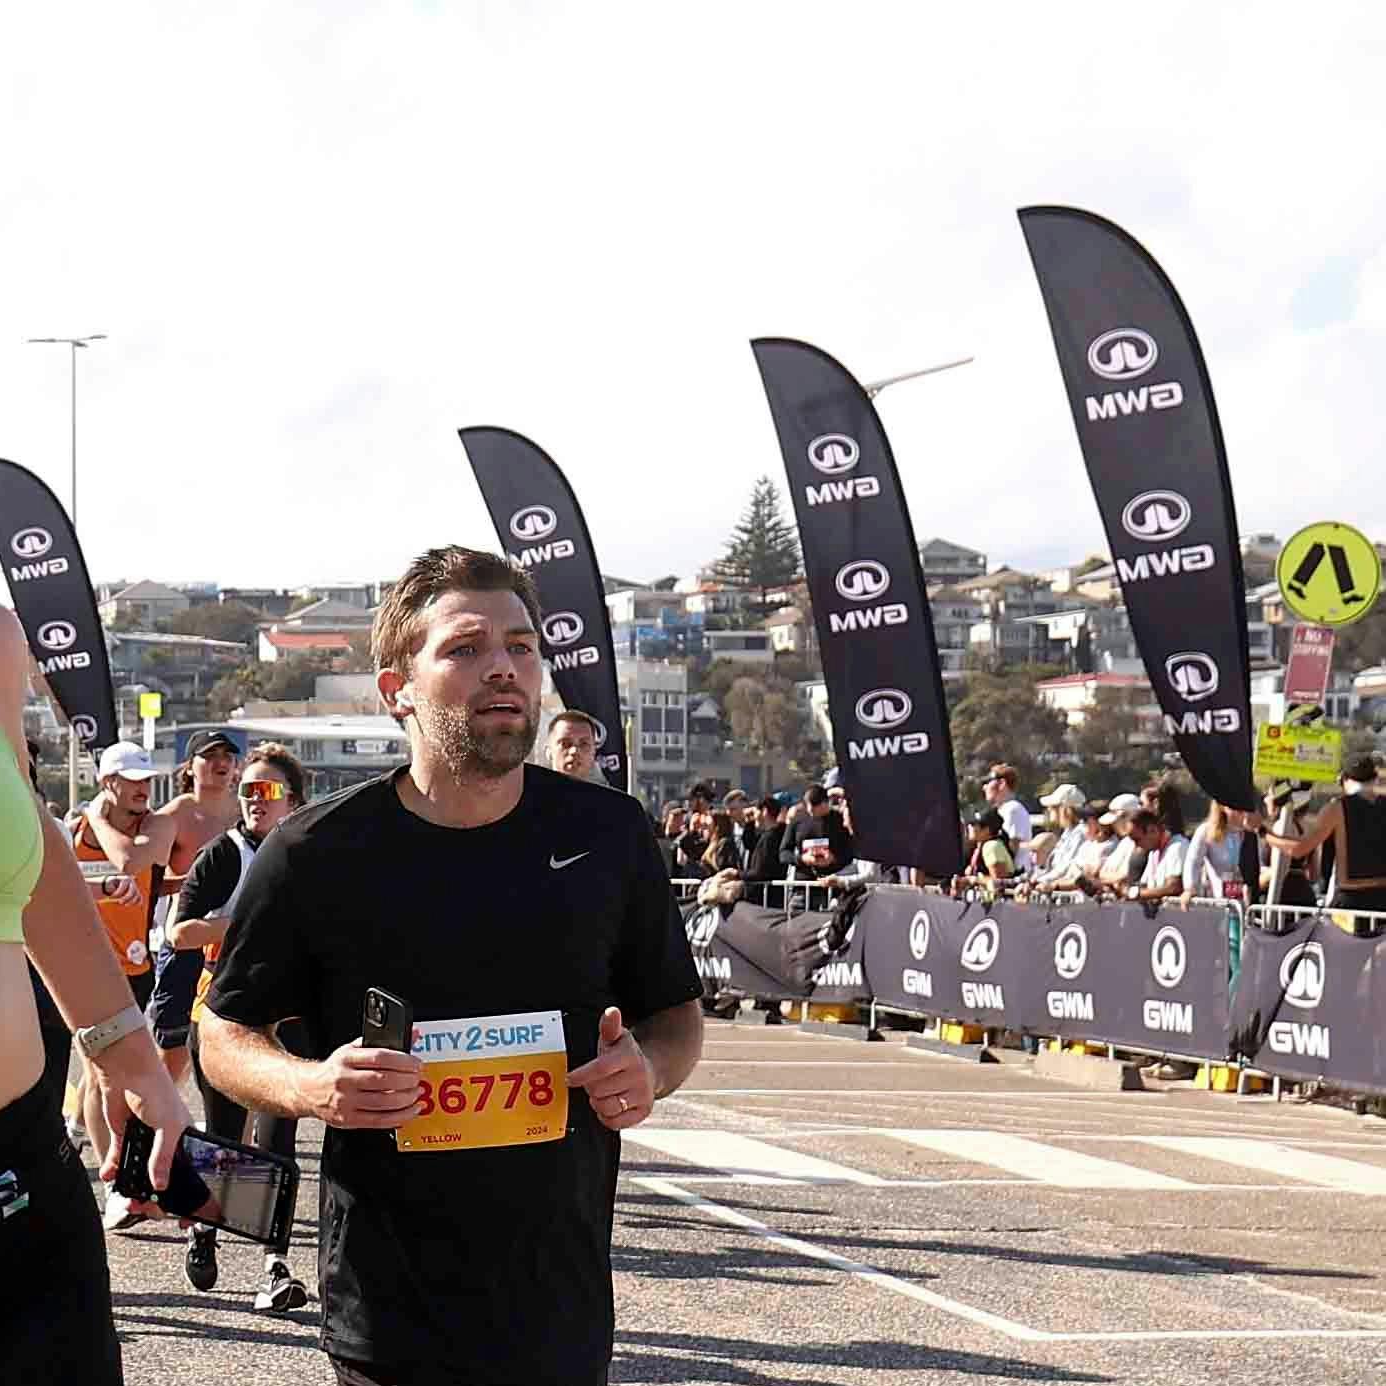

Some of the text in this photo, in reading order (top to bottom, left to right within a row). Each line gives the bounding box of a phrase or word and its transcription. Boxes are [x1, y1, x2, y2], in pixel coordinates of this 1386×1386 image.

[693, 956, 732, 979] WM
[961, 982, 1005, 1010] GWM
[1047, 991, 1094, 1020] GWM
[1143, 999, 1193, 1033] GWM
[420, 1133, 462, 1145] YELLOW
[525, 1125, 549, 1136] 2024
